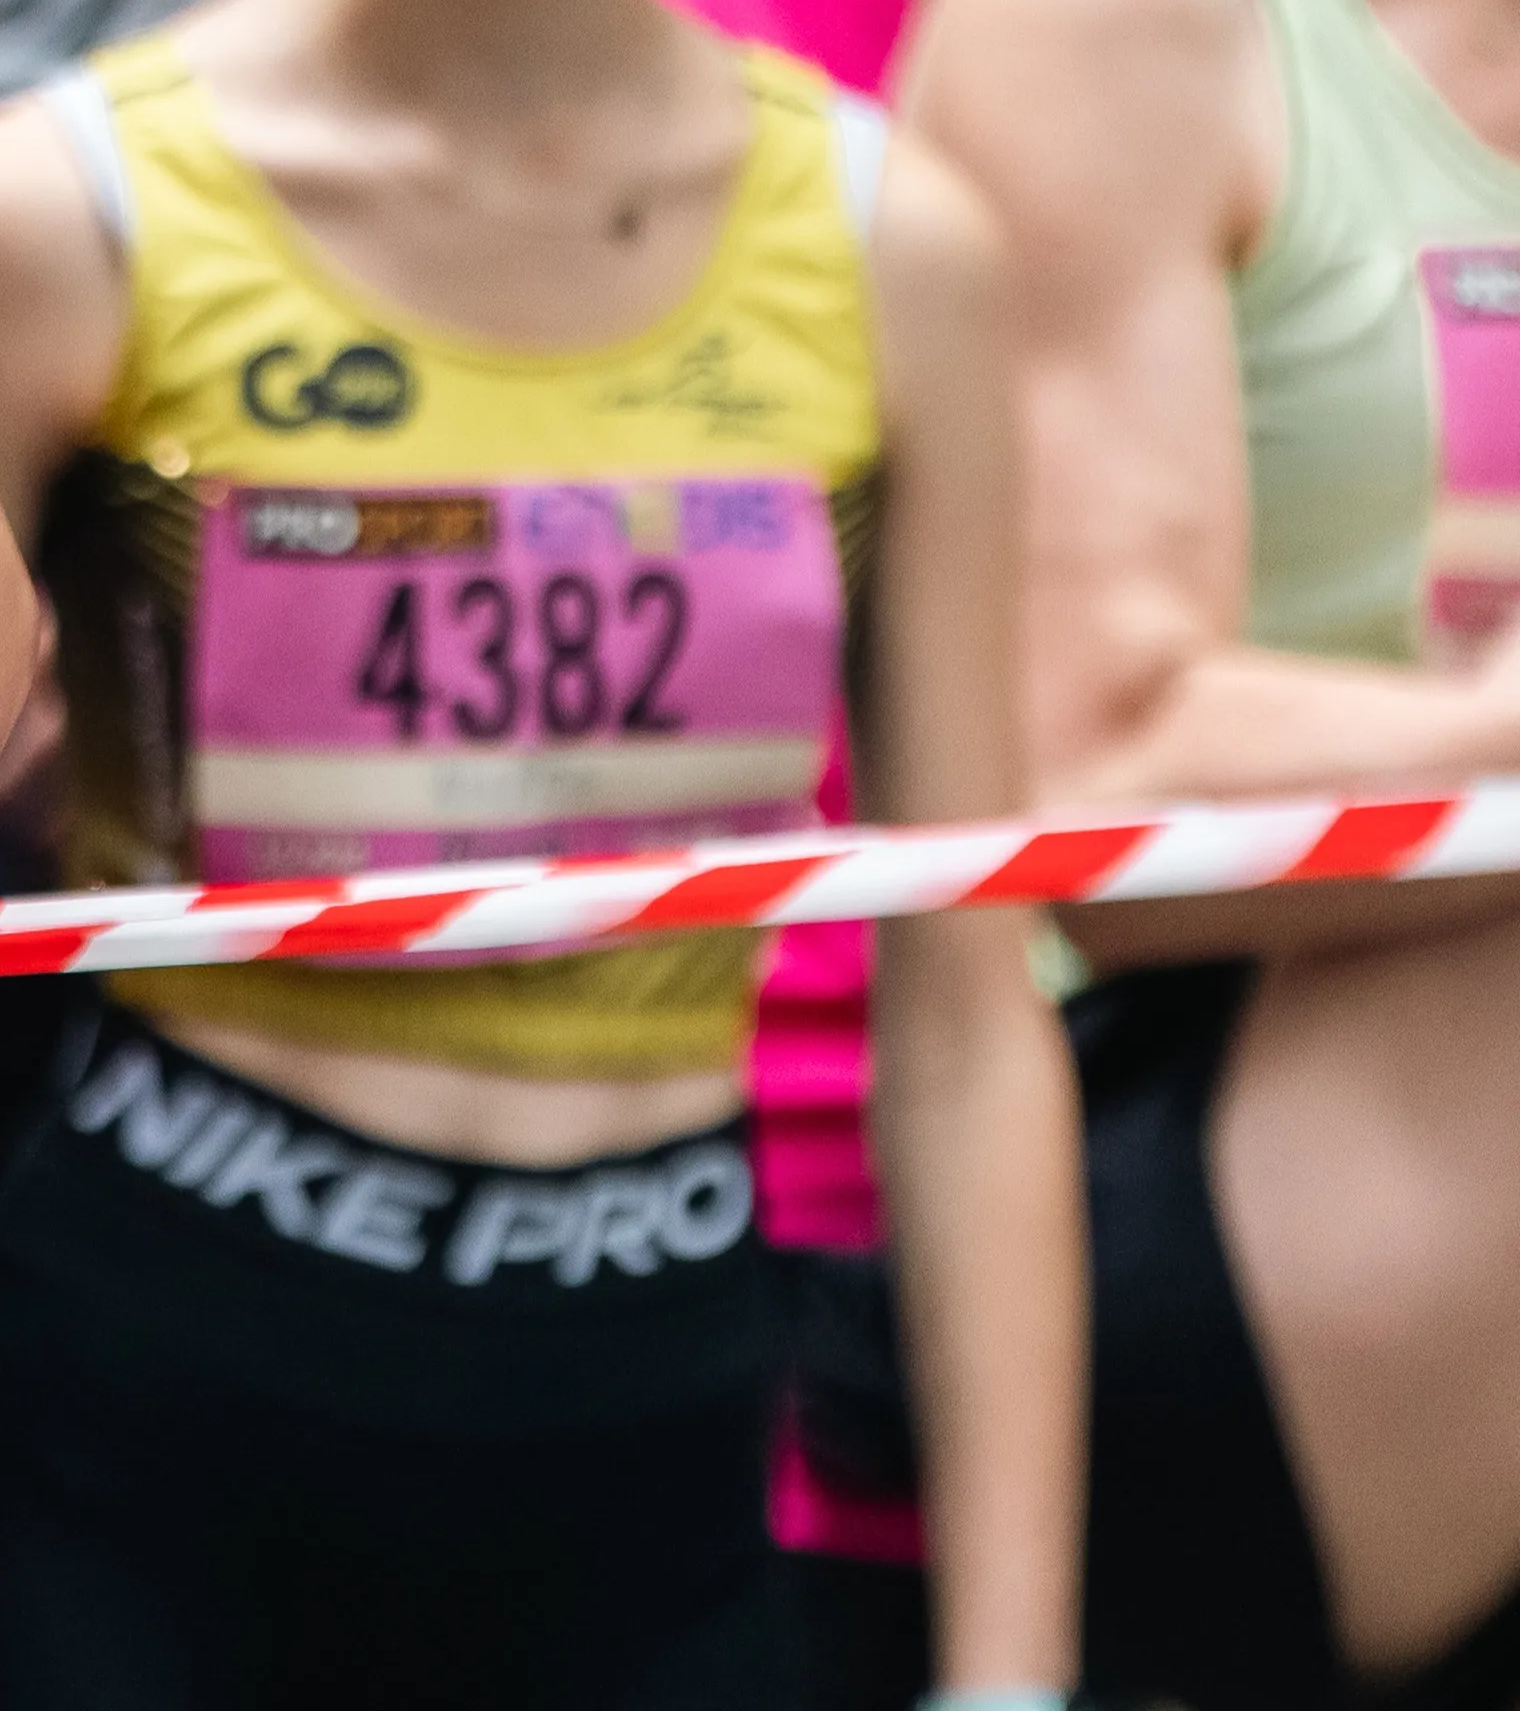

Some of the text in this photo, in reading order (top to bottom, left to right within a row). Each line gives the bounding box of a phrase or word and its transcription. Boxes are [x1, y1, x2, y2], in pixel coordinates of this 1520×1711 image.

[354, 571, 692, 745] 4382
[67, 1043, 755, 1289] NIKE PRO
